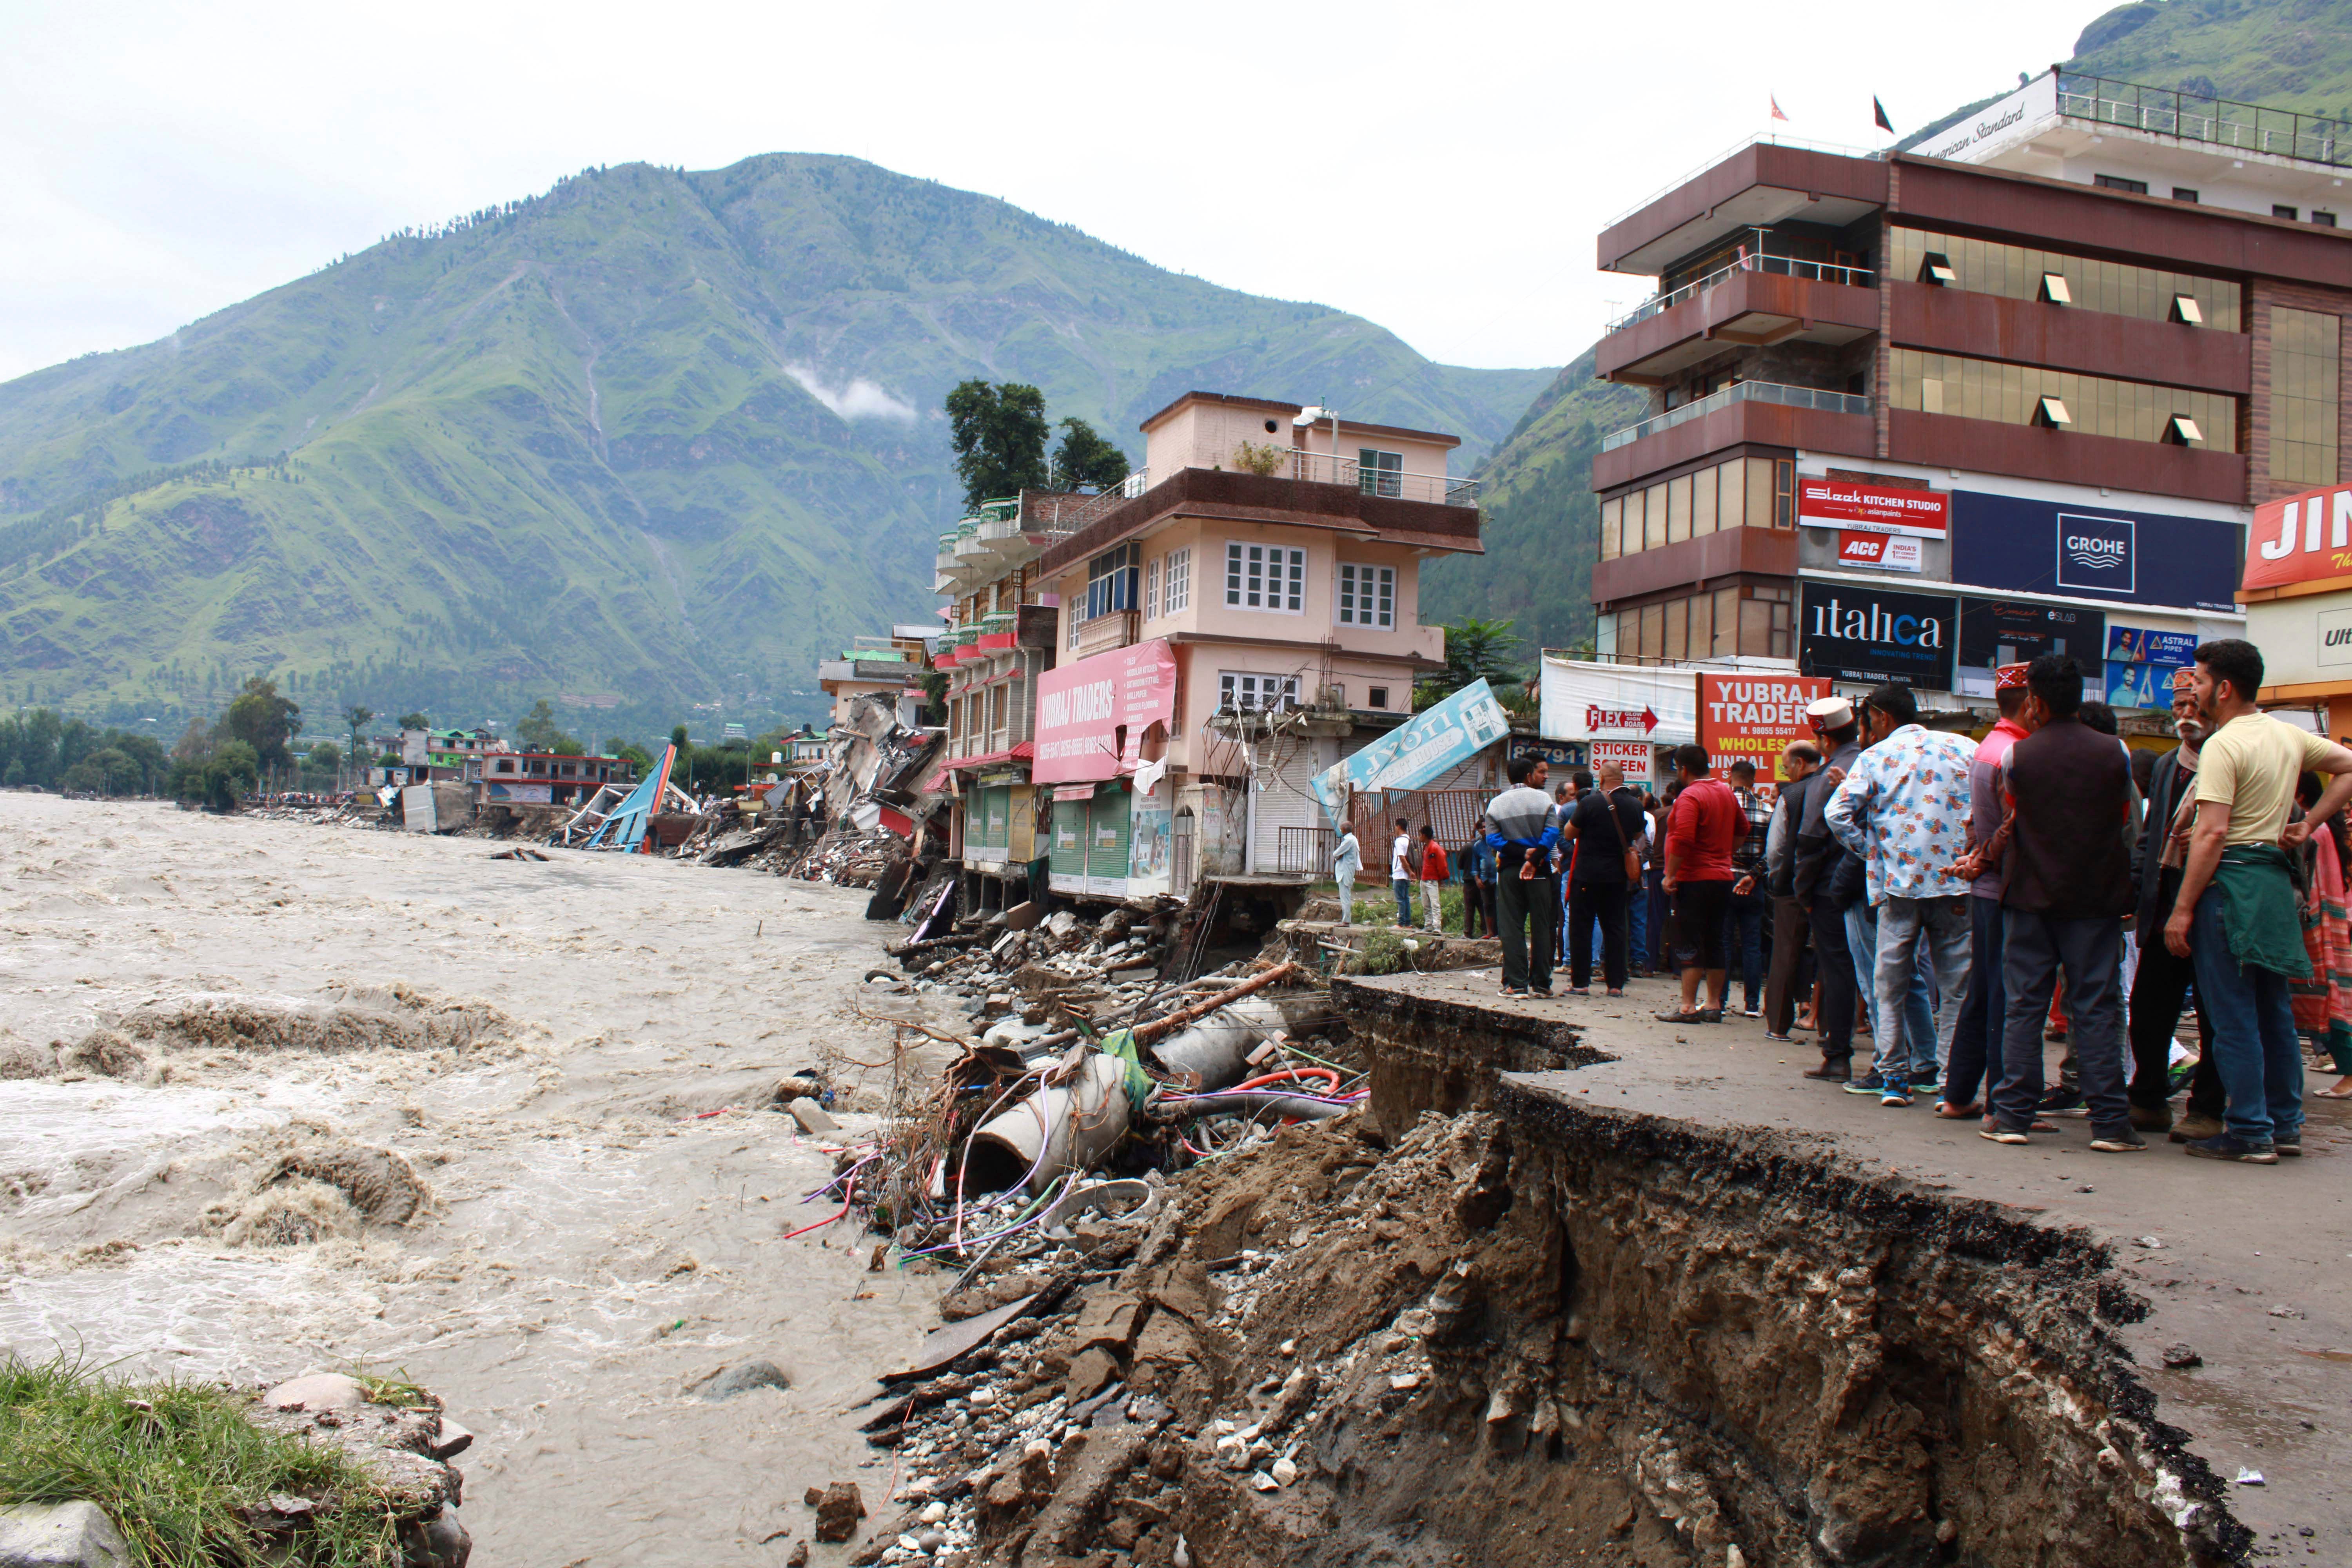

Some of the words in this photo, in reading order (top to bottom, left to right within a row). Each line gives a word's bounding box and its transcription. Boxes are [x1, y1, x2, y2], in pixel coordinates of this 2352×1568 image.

[1972, 100, 2025, 143] Standard
[1806, 487, 1861, 503] Sleek
[1863, 495, 1904, 508] KITCHEN
[1906, 499, 1941, 512] STUDIO
[1867, 508, 1902, 518] asianpaints
[1846, 523, 1871, 532] YUBRAJ
[1844, 541, 1880, 556] ACC
[2066, 535, 2126, 555] GROHE
[2331, 552, 2352, 569] Th
[1812, 599, 1943, 648] italica
[2162, 636, 2194, 646] ASTRAL
[1127, 657, 1136, 665] TILES
[1869, 648, 1910, 659] INNOVATING
[1912, 652, 1938, 661] TRENDS
[1142, 664, 1158, 674] KITCHEN
[1841, 670, 1862, 680] YUBRAJ
[1863, 672, 1890, 682] TRADERS,
[1127, 678, 1145, 689] BATHROOM
[1145, 675, 1159, 685] FITTING
[1127, 690, 1147, 700] WALLPAPER
[1716, 681, 1818, 704] YUBRAJ
[1042, 689, 1071, 730] YUBRAJ
[1072, 679, 1112, 723] TRADERS
[1126, 702, 1141, 711] WOODEN
[1141, 699, 1159, 709] FLOORING
[1126, 713, 1143, 723] LAMINATE
[1591, 710, 1622, 727] FLEX
[1709, 702, 1809, 724] TRADER
[1366, 711, 1454, 775] JYOTI
[1415, 733, 1455, 767] HOUSE
[1593, 743, 1648, 756] STICKER
[1719, 737, 1816, 751] WHOLES
[1593, 759, 1646, 772] SEEN
